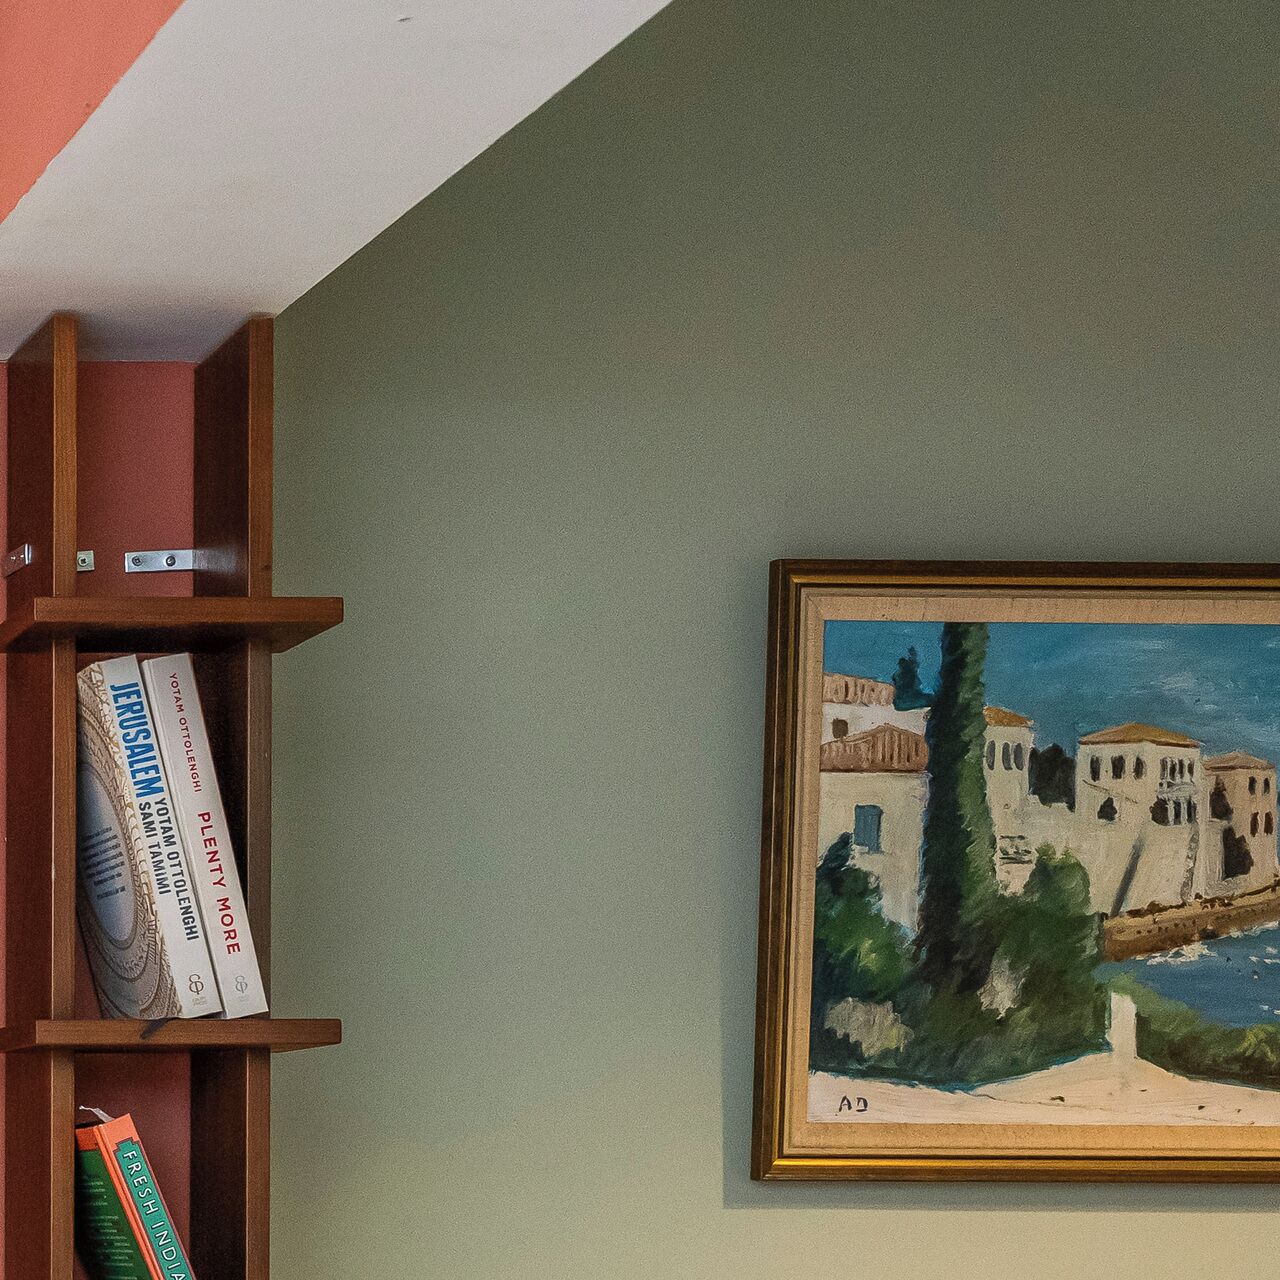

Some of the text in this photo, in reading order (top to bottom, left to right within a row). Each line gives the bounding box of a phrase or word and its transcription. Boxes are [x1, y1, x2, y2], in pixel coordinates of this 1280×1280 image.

[109, 679, 164, 799] JERUSALEM
[168, 672, 202, 792] YOTAM OTTOLENGHI
[137, 800, 171, 894] SAMI TAMIMI
[153, 797, 198, 941] YOTAM OTTOLENGHI
[196, 811, 240, 954] PLENTY MORE
[121, 1147, 161, 1216] FRESH
